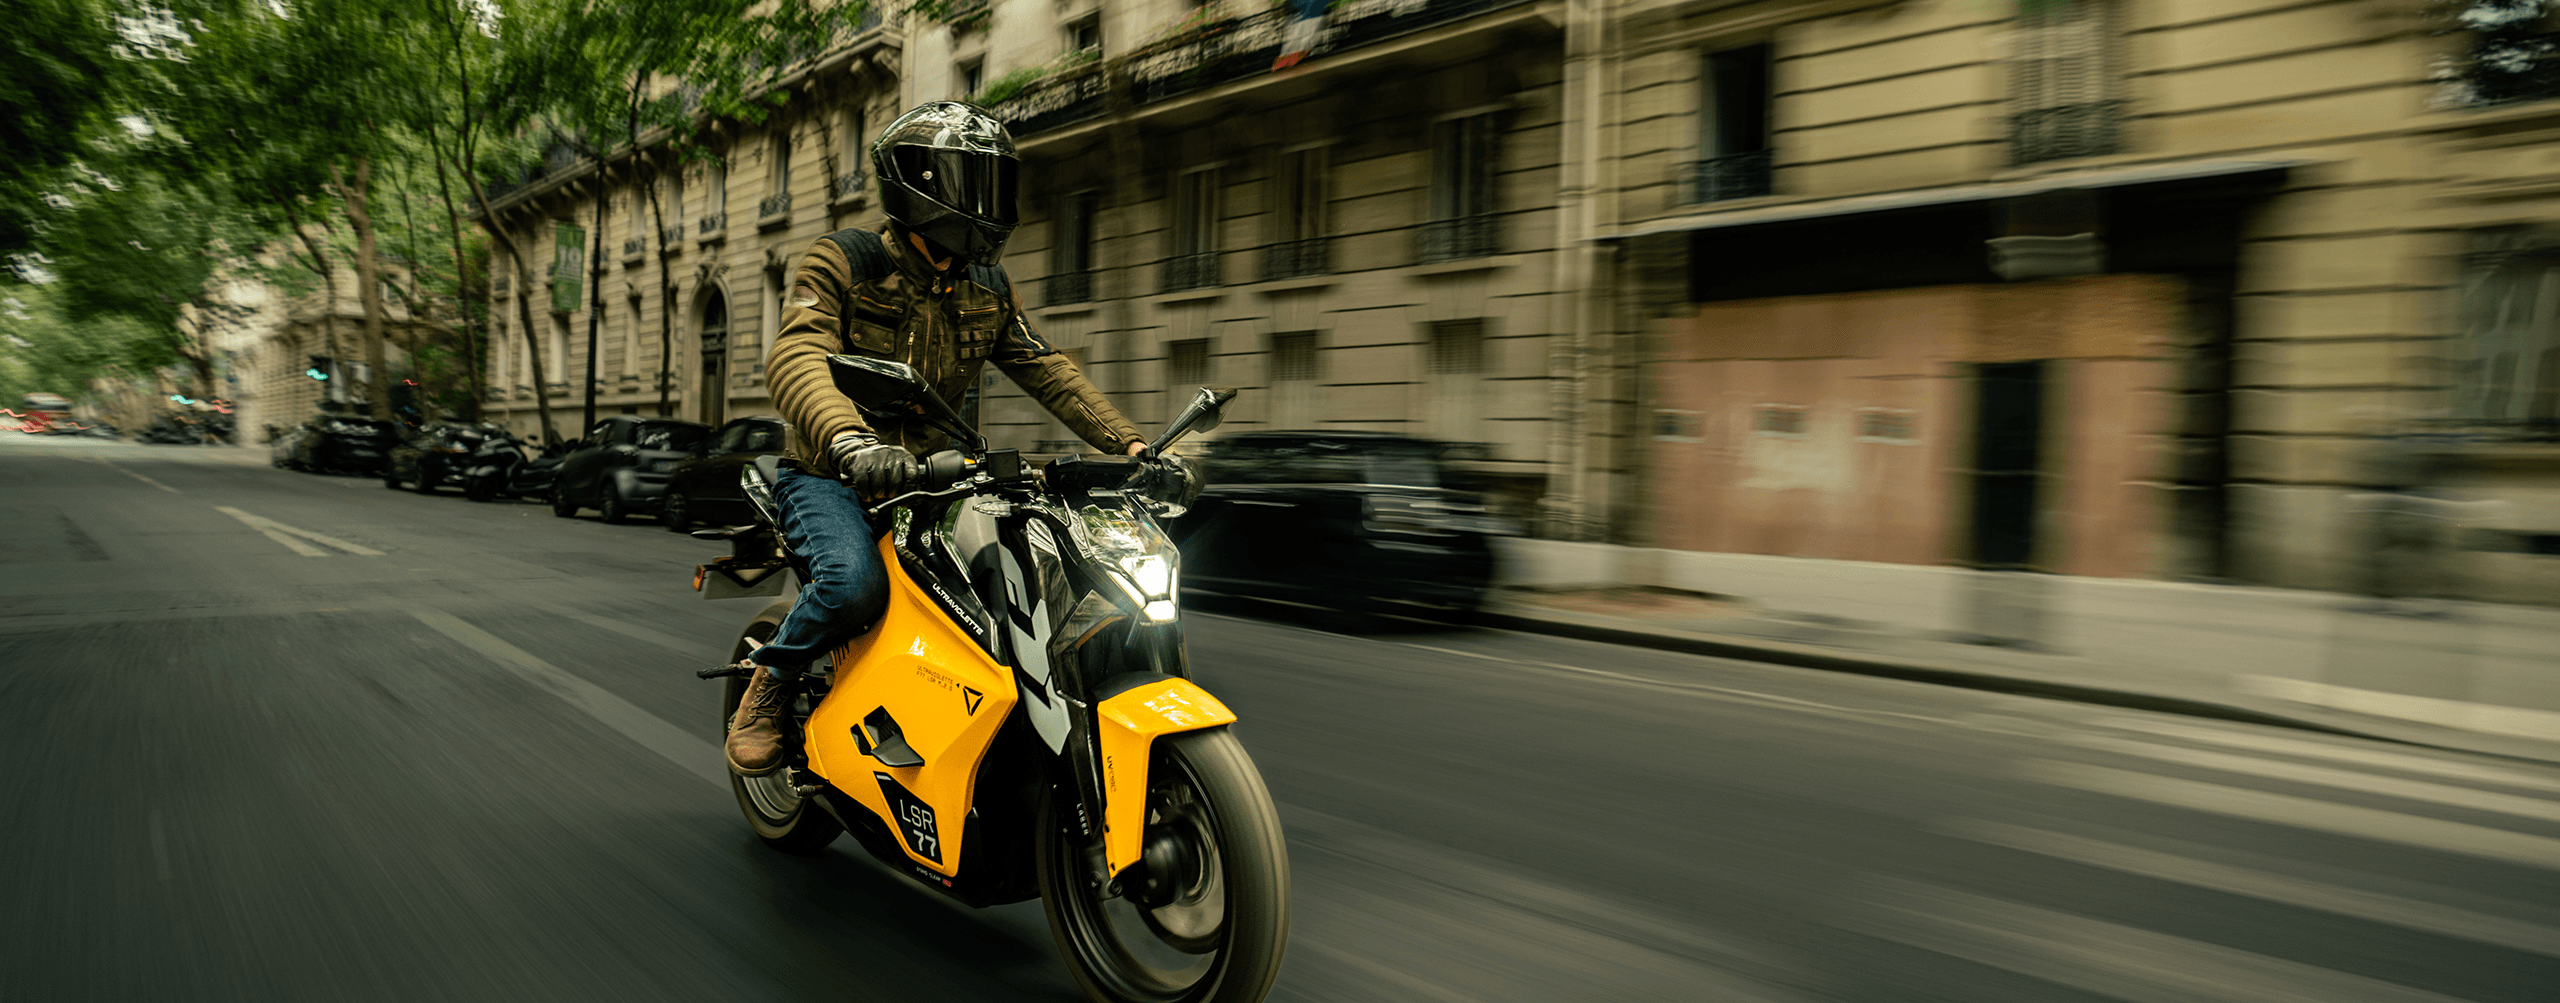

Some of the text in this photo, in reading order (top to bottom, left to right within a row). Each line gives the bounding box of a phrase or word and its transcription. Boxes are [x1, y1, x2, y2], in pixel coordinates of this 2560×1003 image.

[932, 582, 984, 636] ULTRAVIOLETTE
[900, 799, 934, 833] LSR
[913, 829, 936, 857] 77
